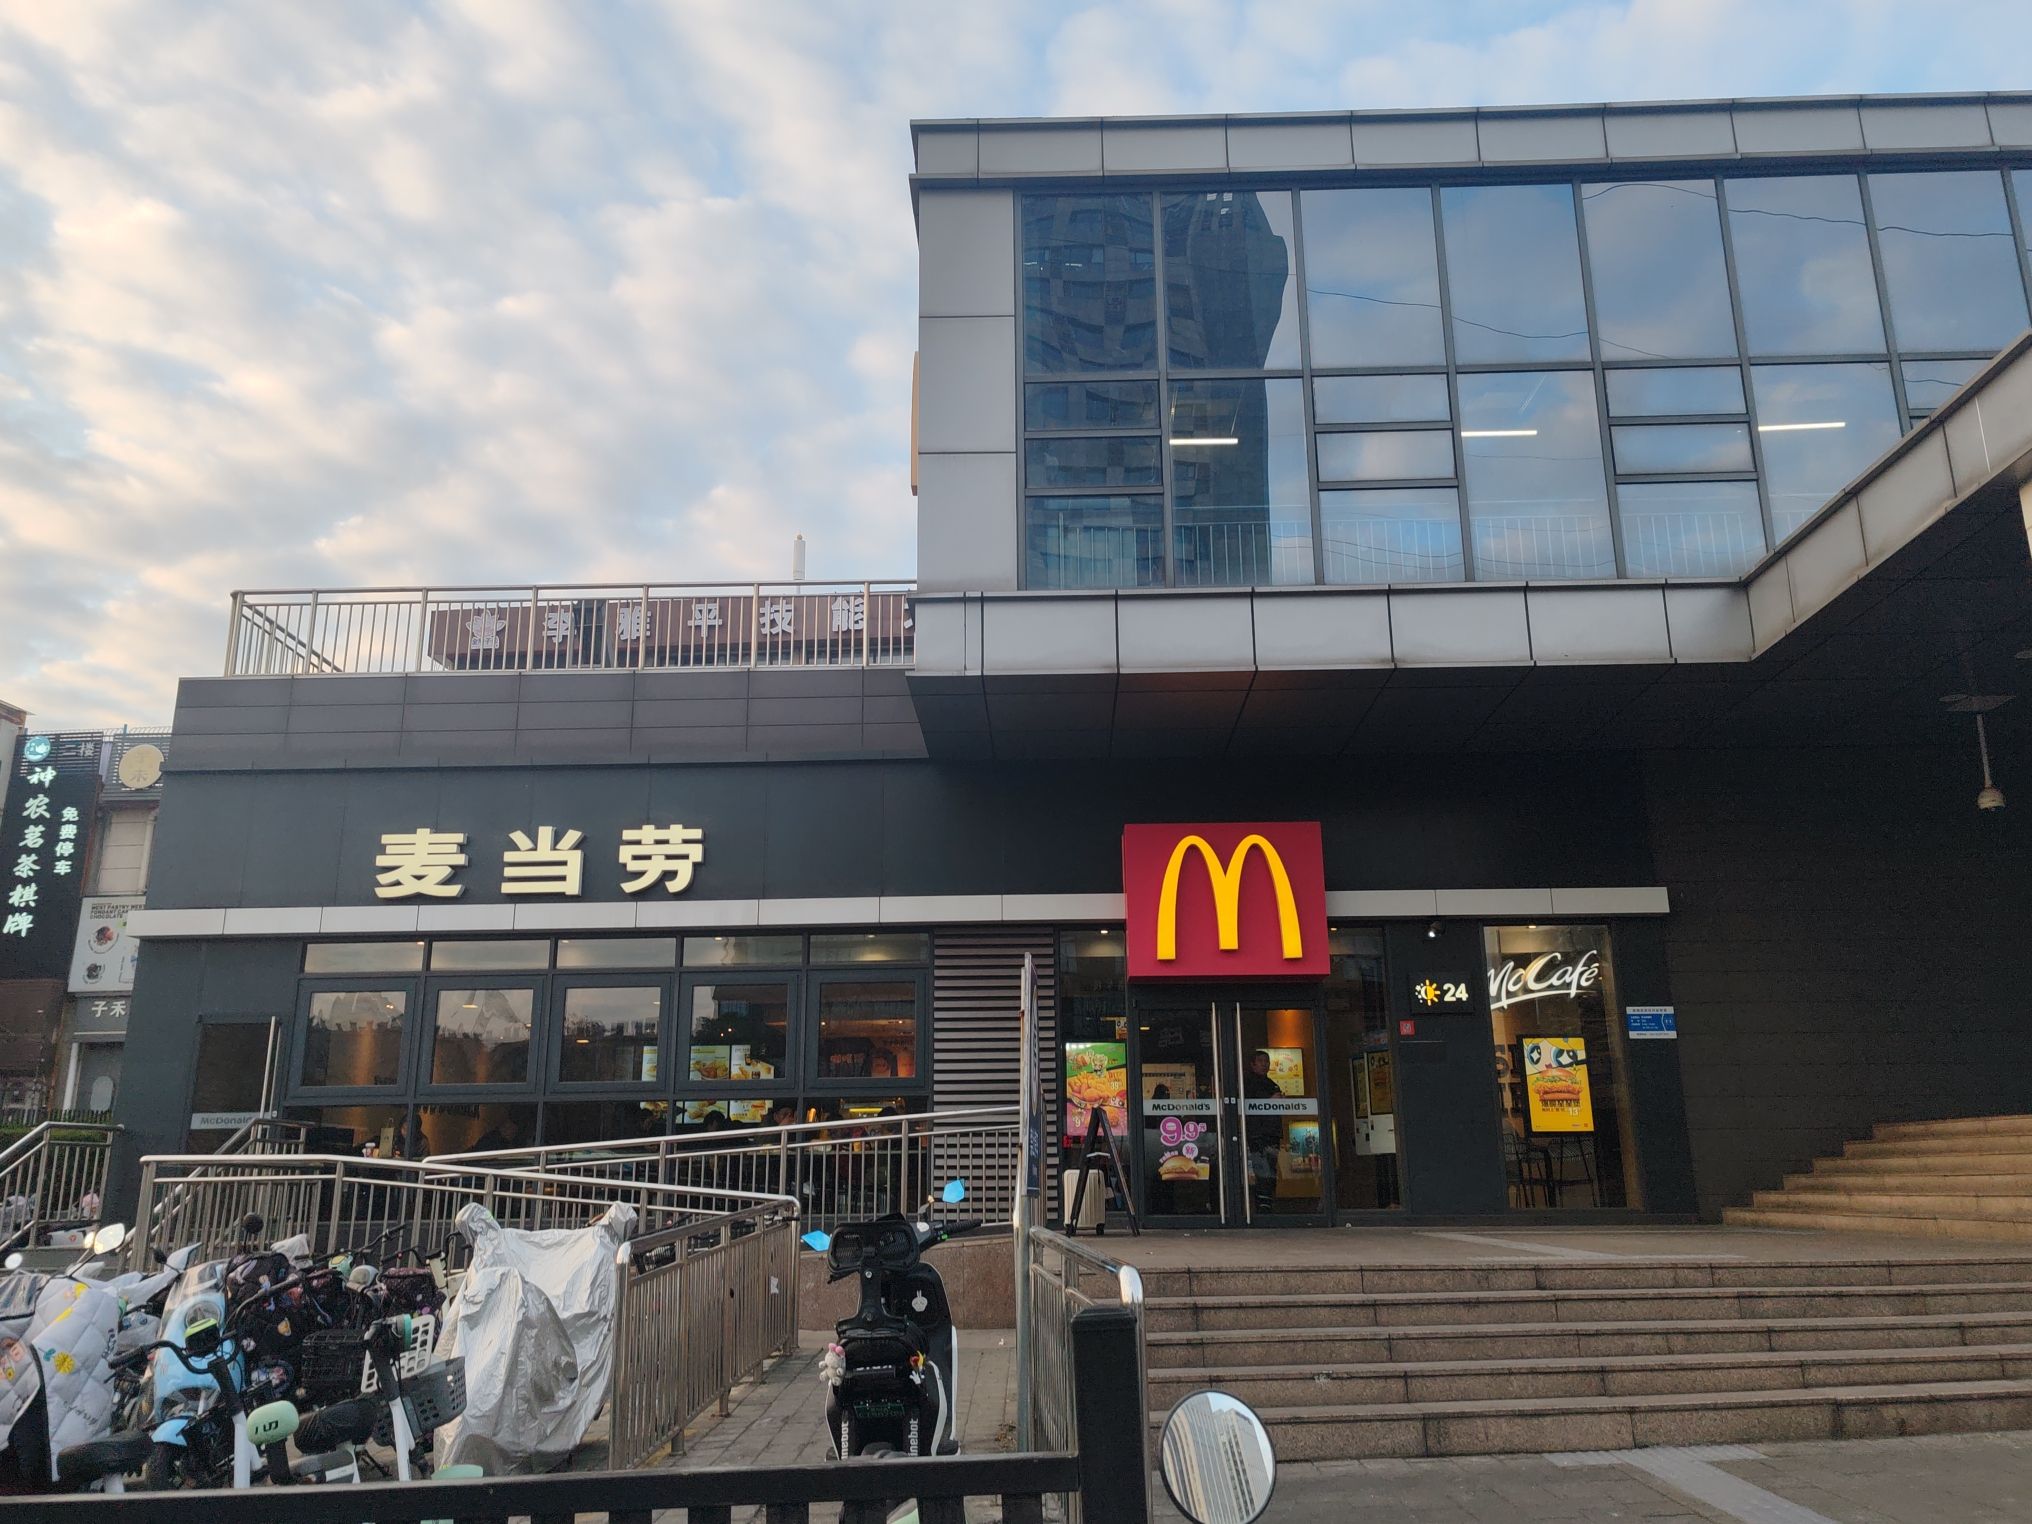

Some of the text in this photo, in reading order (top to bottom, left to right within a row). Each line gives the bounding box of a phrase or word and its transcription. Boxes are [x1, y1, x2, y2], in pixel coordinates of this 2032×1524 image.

[542, 596, 914, 643] 李雅平技能
[2, 766, 56, 938] 神农茗茶棋牌
[53, 806, 79, 876] 免费停车
[374, 824, 705, 898] 麦当劳
[91, 1000, 127, 1018] 子禾
[1442, 983, 1469, 1001] 24
[1151, 1102, 1211, 1112] McDonald's
[1247, 1102, 1308, 1112] McDonald's
[907, 1418, 919, 1457] inebot
